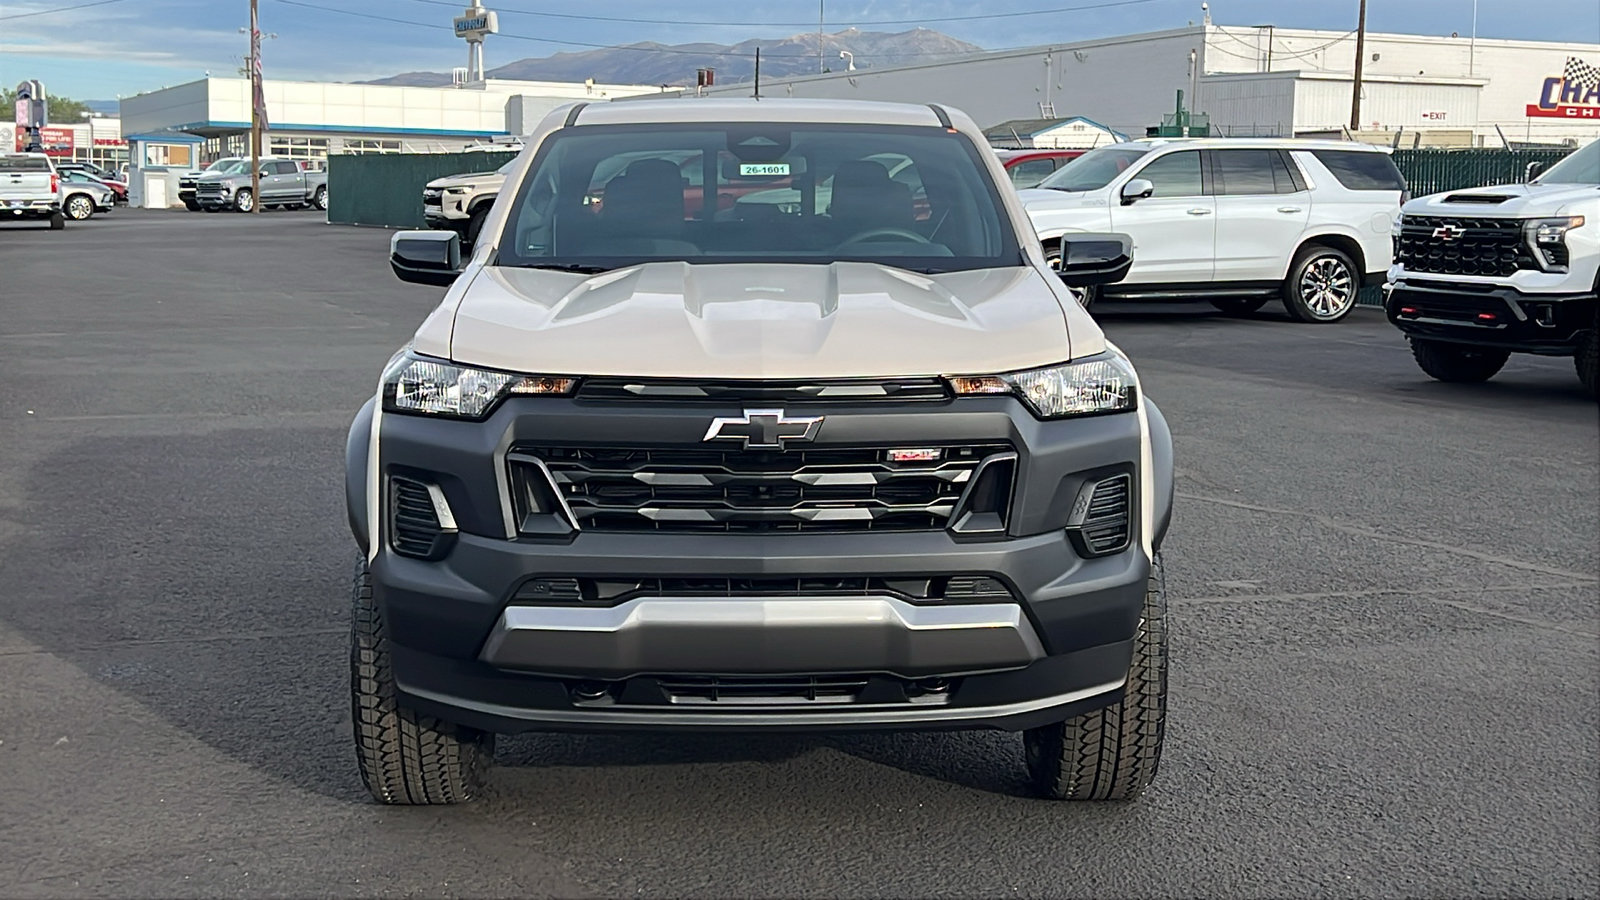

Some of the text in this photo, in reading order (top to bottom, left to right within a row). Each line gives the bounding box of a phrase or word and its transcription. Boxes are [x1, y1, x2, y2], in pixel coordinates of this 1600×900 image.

[1539, 77, 1600, 109] CHA
[1429, 112, 1446, 120] EXIT
[1566, 108, 1600, 116] CH
